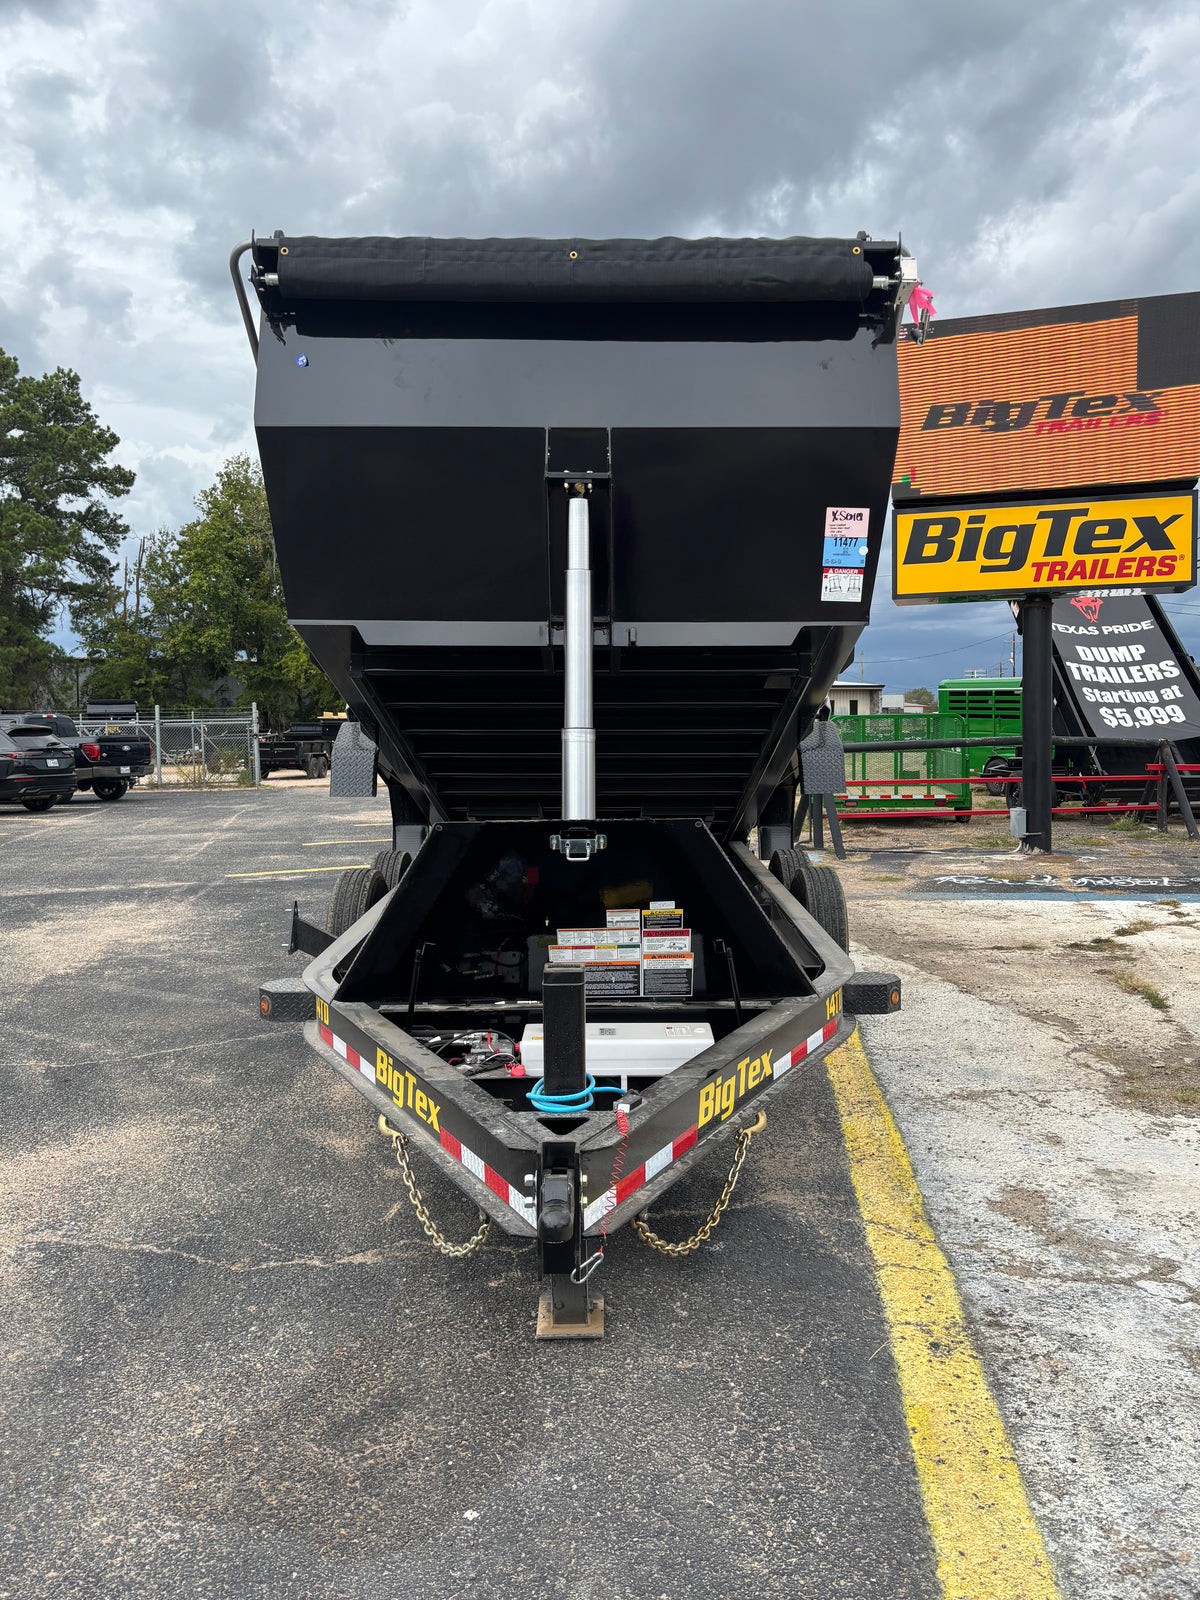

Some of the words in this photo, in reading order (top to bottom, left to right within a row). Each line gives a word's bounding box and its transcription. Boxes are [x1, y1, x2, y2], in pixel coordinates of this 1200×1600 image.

[834, 537, 858, 547] 11477
[902, 508, 1185, 573] BigTex
[1031, 555, 1178, 583] TRAILERS
[1052, 622, 1099, 635] TEXAS
[1102, 619, 1155, 635] PRIDE
[1075, 644, 1146, 663] DUMP
[1065, 660, 1181, 684] TRAILERS
[1082, 687, 1160, 704] Starting
[1162, 684, 1184, 700] at
[1099, 705, 1186, 728] $5,999
[376, 1047, 441, 1134] BigTex
[698, 1048, 774, 1130] BigTex
